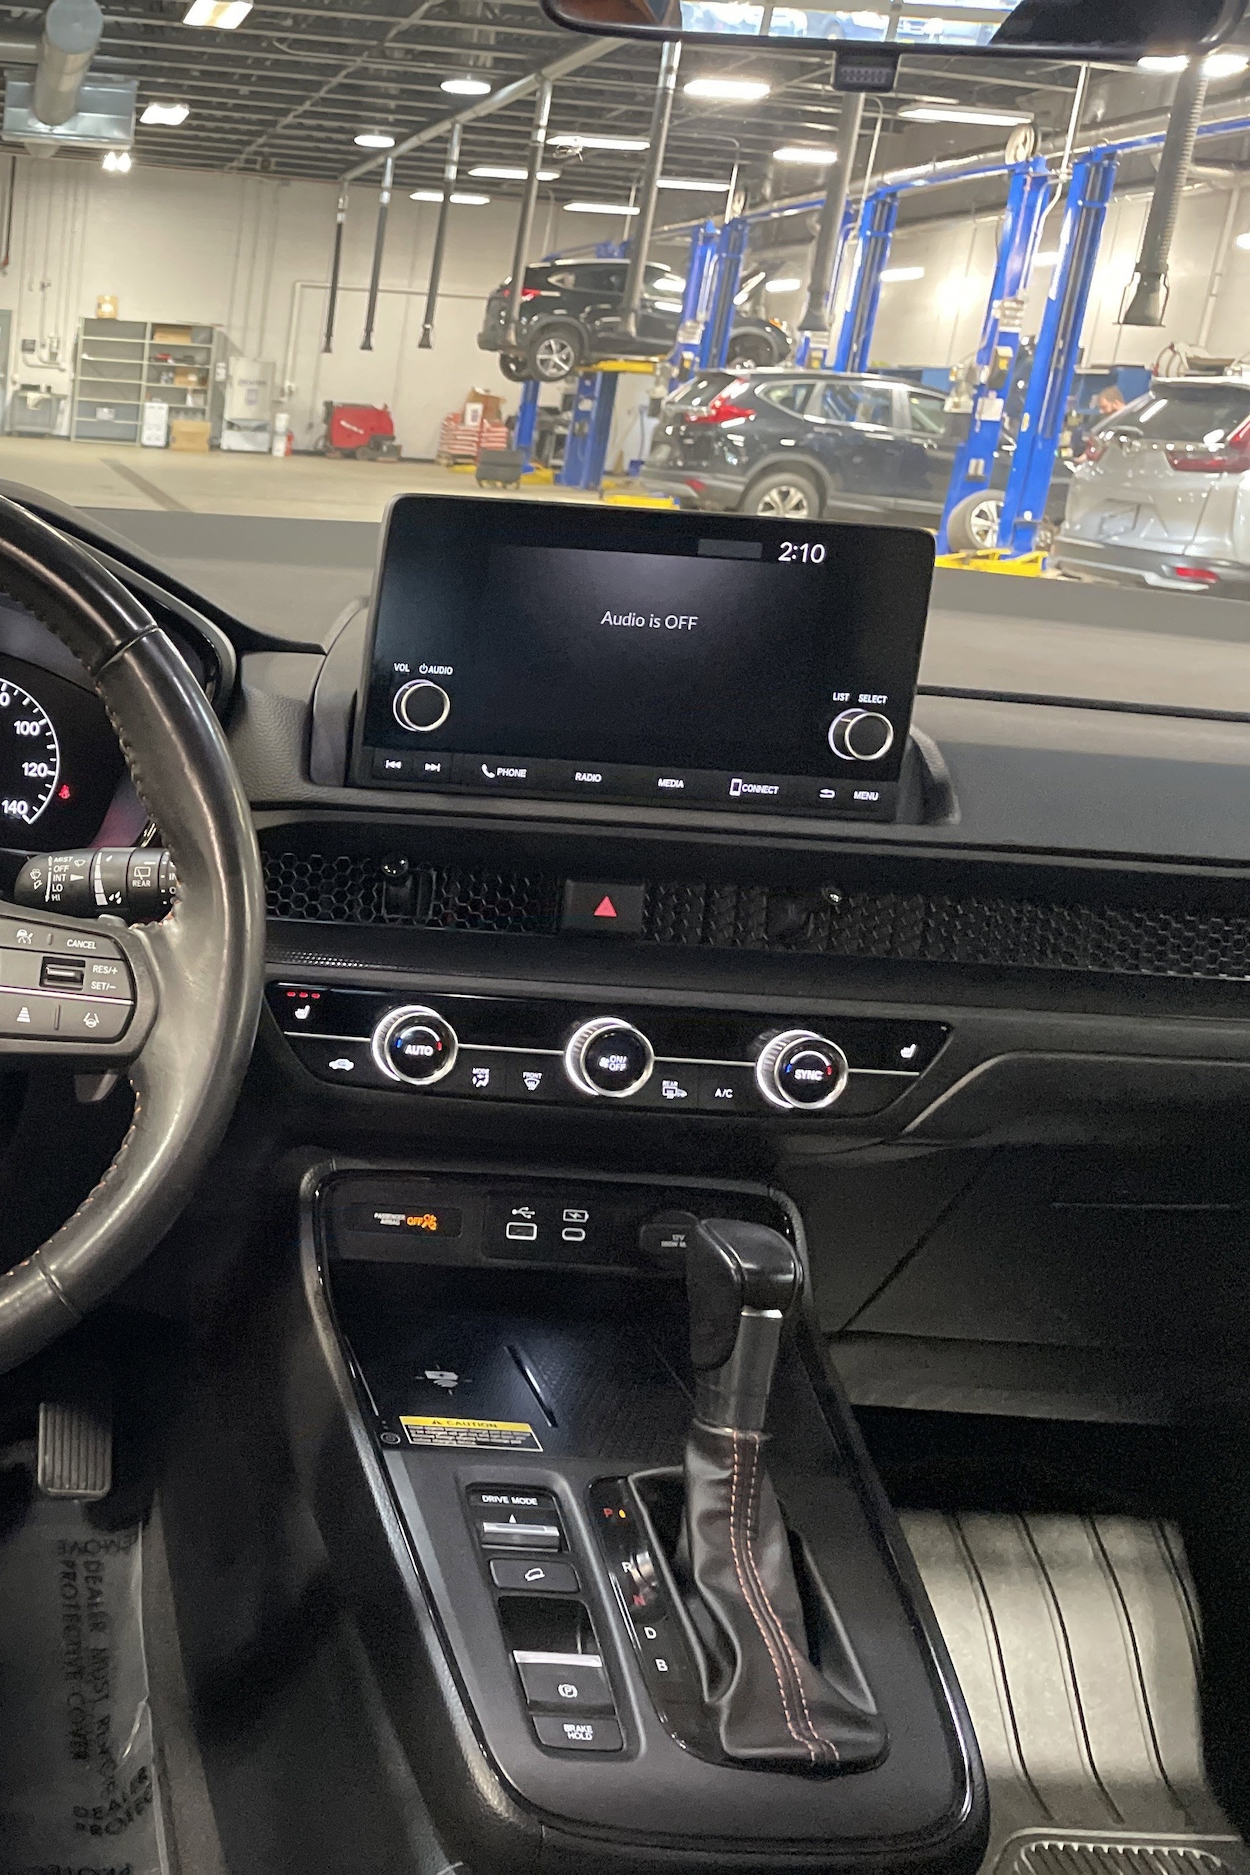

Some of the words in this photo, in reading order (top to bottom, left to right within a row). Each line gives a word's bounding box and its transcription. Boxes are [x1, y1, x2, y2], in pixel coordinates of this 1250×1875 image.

[778, 541, 826, 564] 2:10
[600, 610, 646, 628] Audio
[649, 613, 661, 629] is
[665, 614, 699, 631] OFF
[393, 663, 410, 673] VOL
[428, 665, 453, 675] AUDIO
[833, 692, 850, 702] LIST
[858, 694, 888, 705] SELECT
[14, 720, 41, 736] 100
[21, 762, 49, 778] 120
[496, 767, 527, 778] PHONE
[575, 772, 602, 783] RADIO
[658, 778, 684, 789] MEDIA
[741, 783, 780, 795] CONNECT
[853, 790, 879, 801] MENU
[1, 799, 29, 815] 140
[53, 855, 74, 863] MIST
[53, 865, 70, 873] OFF
[52, 873, 66, 882] INT
[132, 879, 151, 887] REAR
[52, 884, 63, 893] LO
[51, 893, 61, 902] HI
[66, 939, 97, 950] CANCEL
[92, 965, 118, 975] RES/+
[405, 1044, 434, 1057] AUTO
[609, 1063, 627, 1072] OFF
[522, 1071, 543, 1080] FRONT
[794, 1069, 824, 1080] SYNC
[714, 1087, 734, 1098] A/C
[406, 1216, 423, 1226] OFF
[446, 1420, 498, 1429] CAUTION
[482, 1494, 509, 1504] DRIVE
[511, 1496, 538, 1506] MODE
[603, 1508, 613, 1518] P
[633, 1594, 646, 1606] N
[644, 1627, 657, 1639] D
[655, 1659, 668, 1671] B
[563, 1723, 593, 1734] BRAKE
[568, 1731, 593, 1741] HOLD
